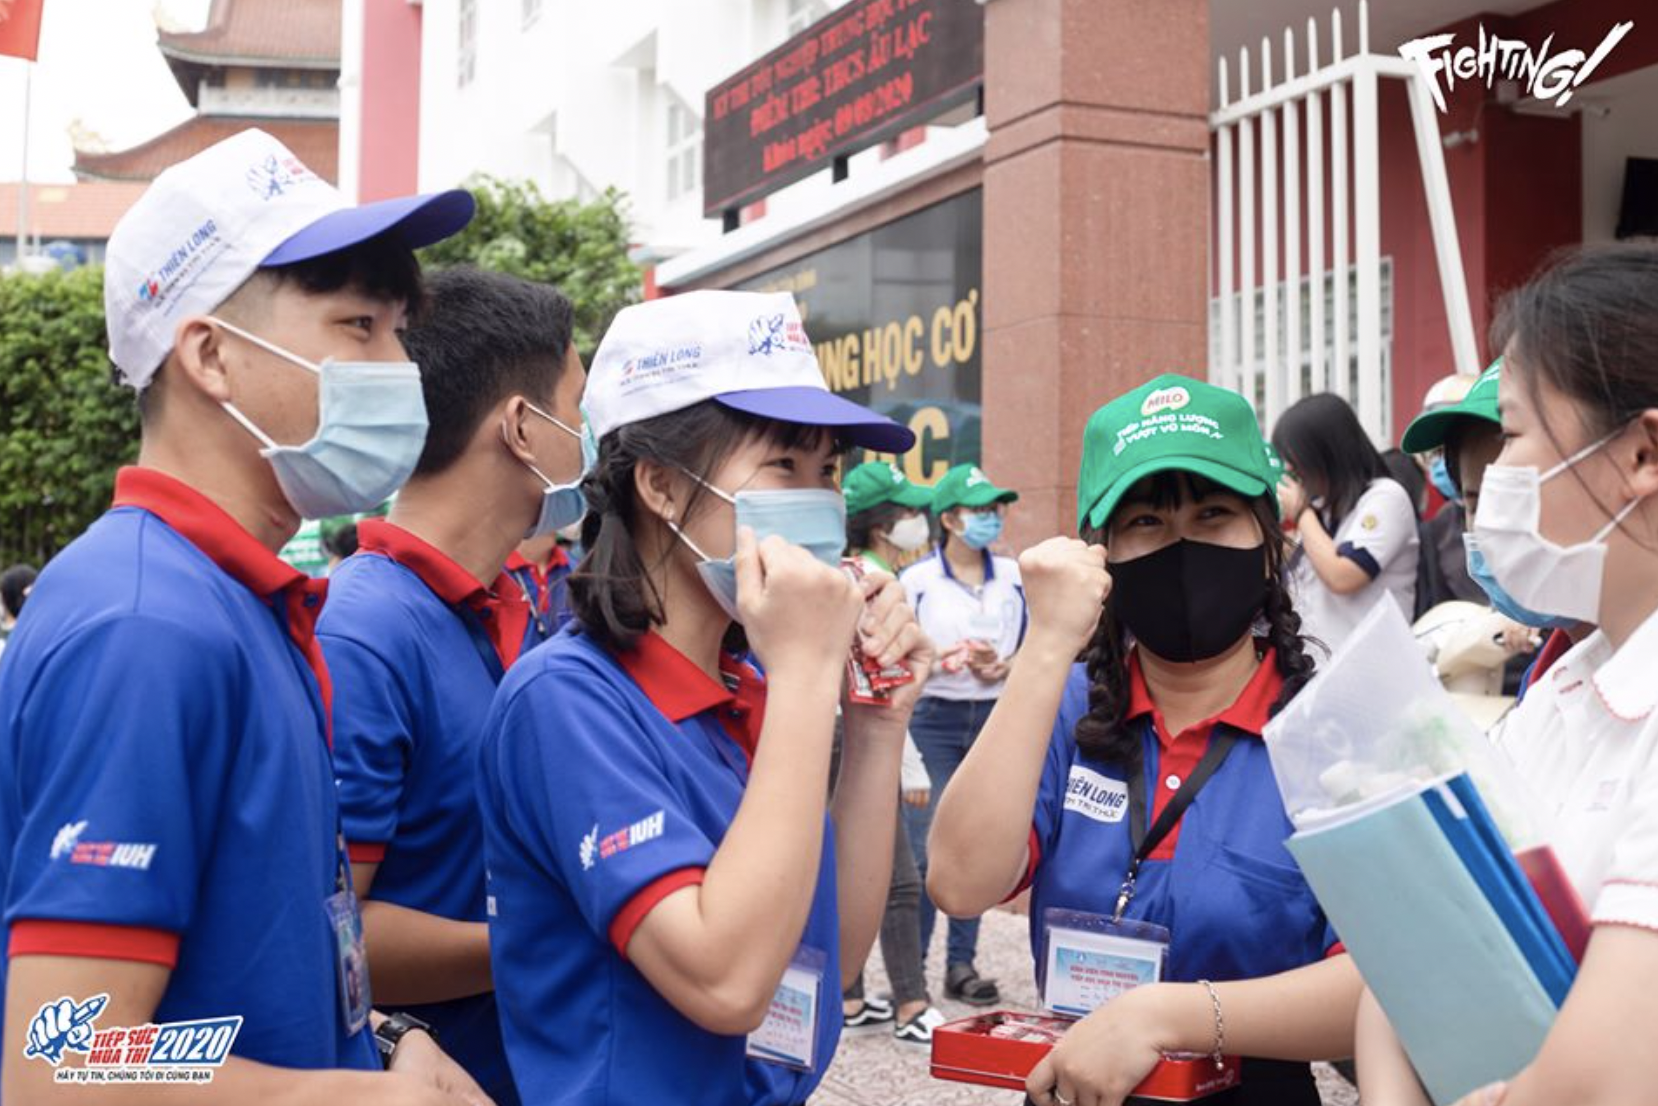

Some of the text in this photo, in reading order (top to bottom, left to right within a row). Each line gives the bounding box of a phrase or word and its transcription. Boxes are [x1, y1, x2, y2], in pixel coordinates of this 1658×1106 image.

[894, 11, 932, 61] LẠC
[188, 218, 218, 253] LONG
[670, 346, 702, 363] LONG
[863, 314, 924, 391] HỌC
[931, 287, 978, 368] CƠ
[1147, 393, 1183, 408] MILO
[1090, 786, 1126, 808] LONG
[629, 808, 665, 846] IUH
[109, 842, 158, 870] IUH
